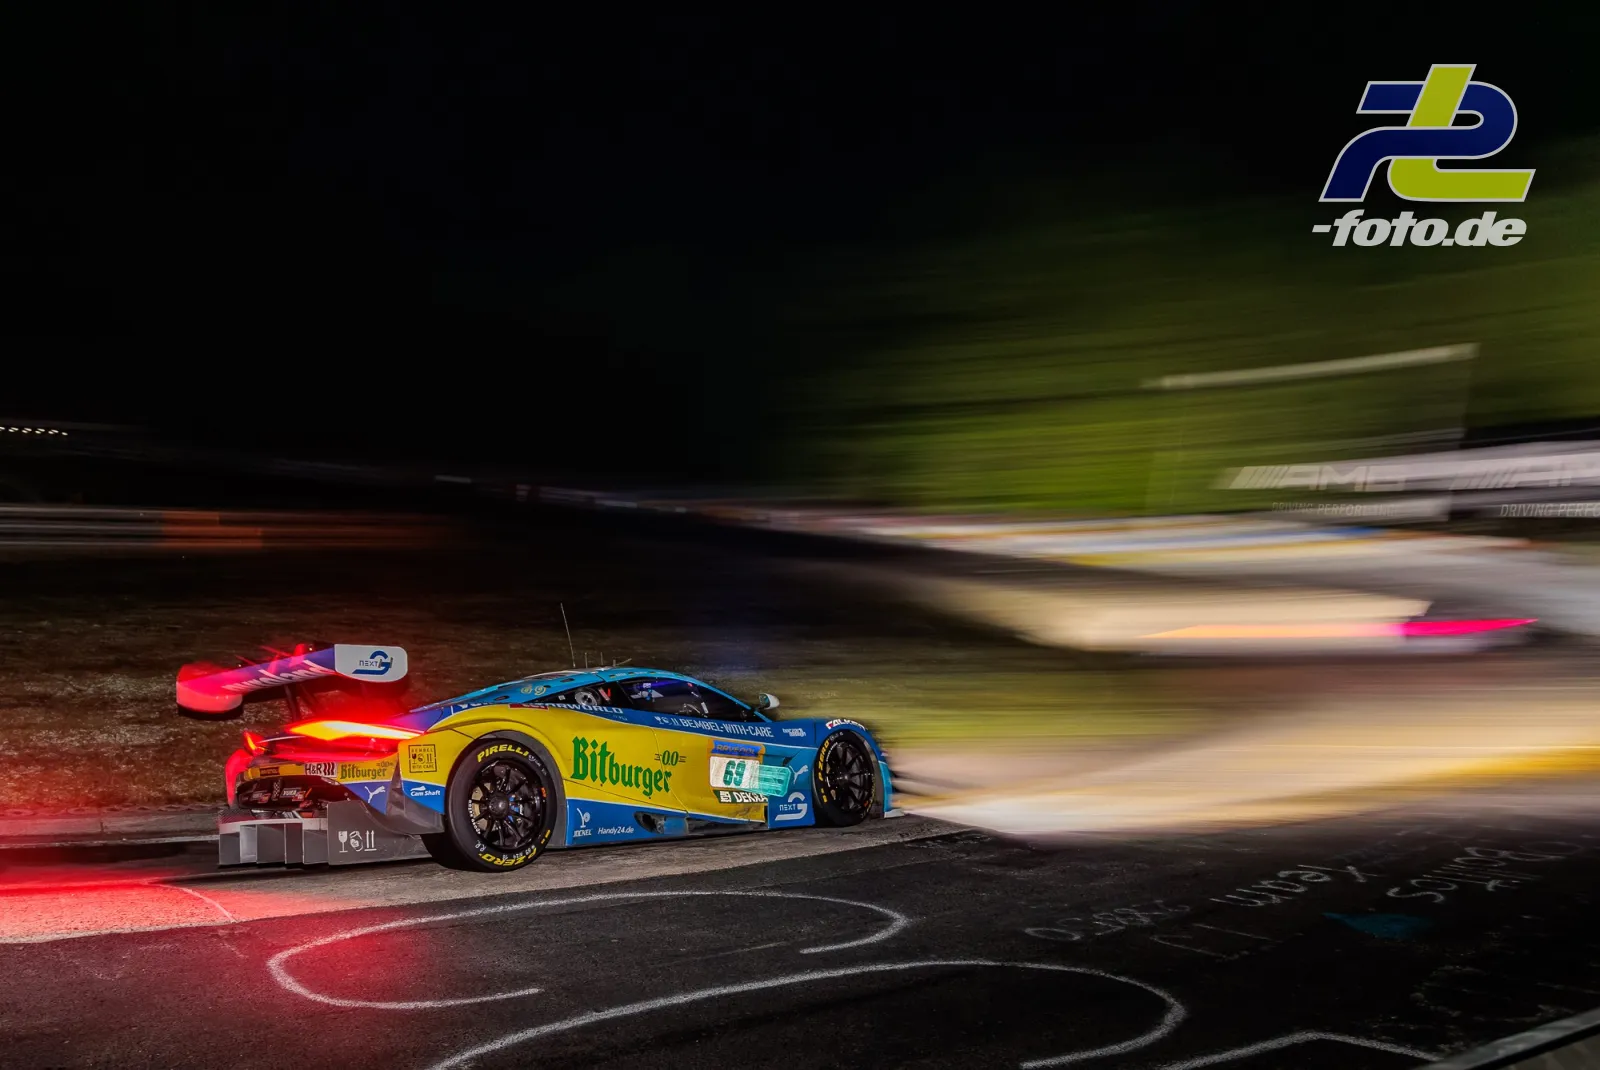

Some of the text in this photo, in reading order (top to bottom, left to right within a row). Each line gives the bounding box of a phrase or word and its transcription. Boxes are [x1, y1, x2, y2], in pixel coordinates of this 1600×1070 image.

[1500, 503, 1554, 517] DRIVING
[477, 744, 529, 762] PIRELLI
[340, 763, 388, 780] Bitburger
[570, 736, 673, 797] Bitburger
[722, 760, 747, 787] 69
